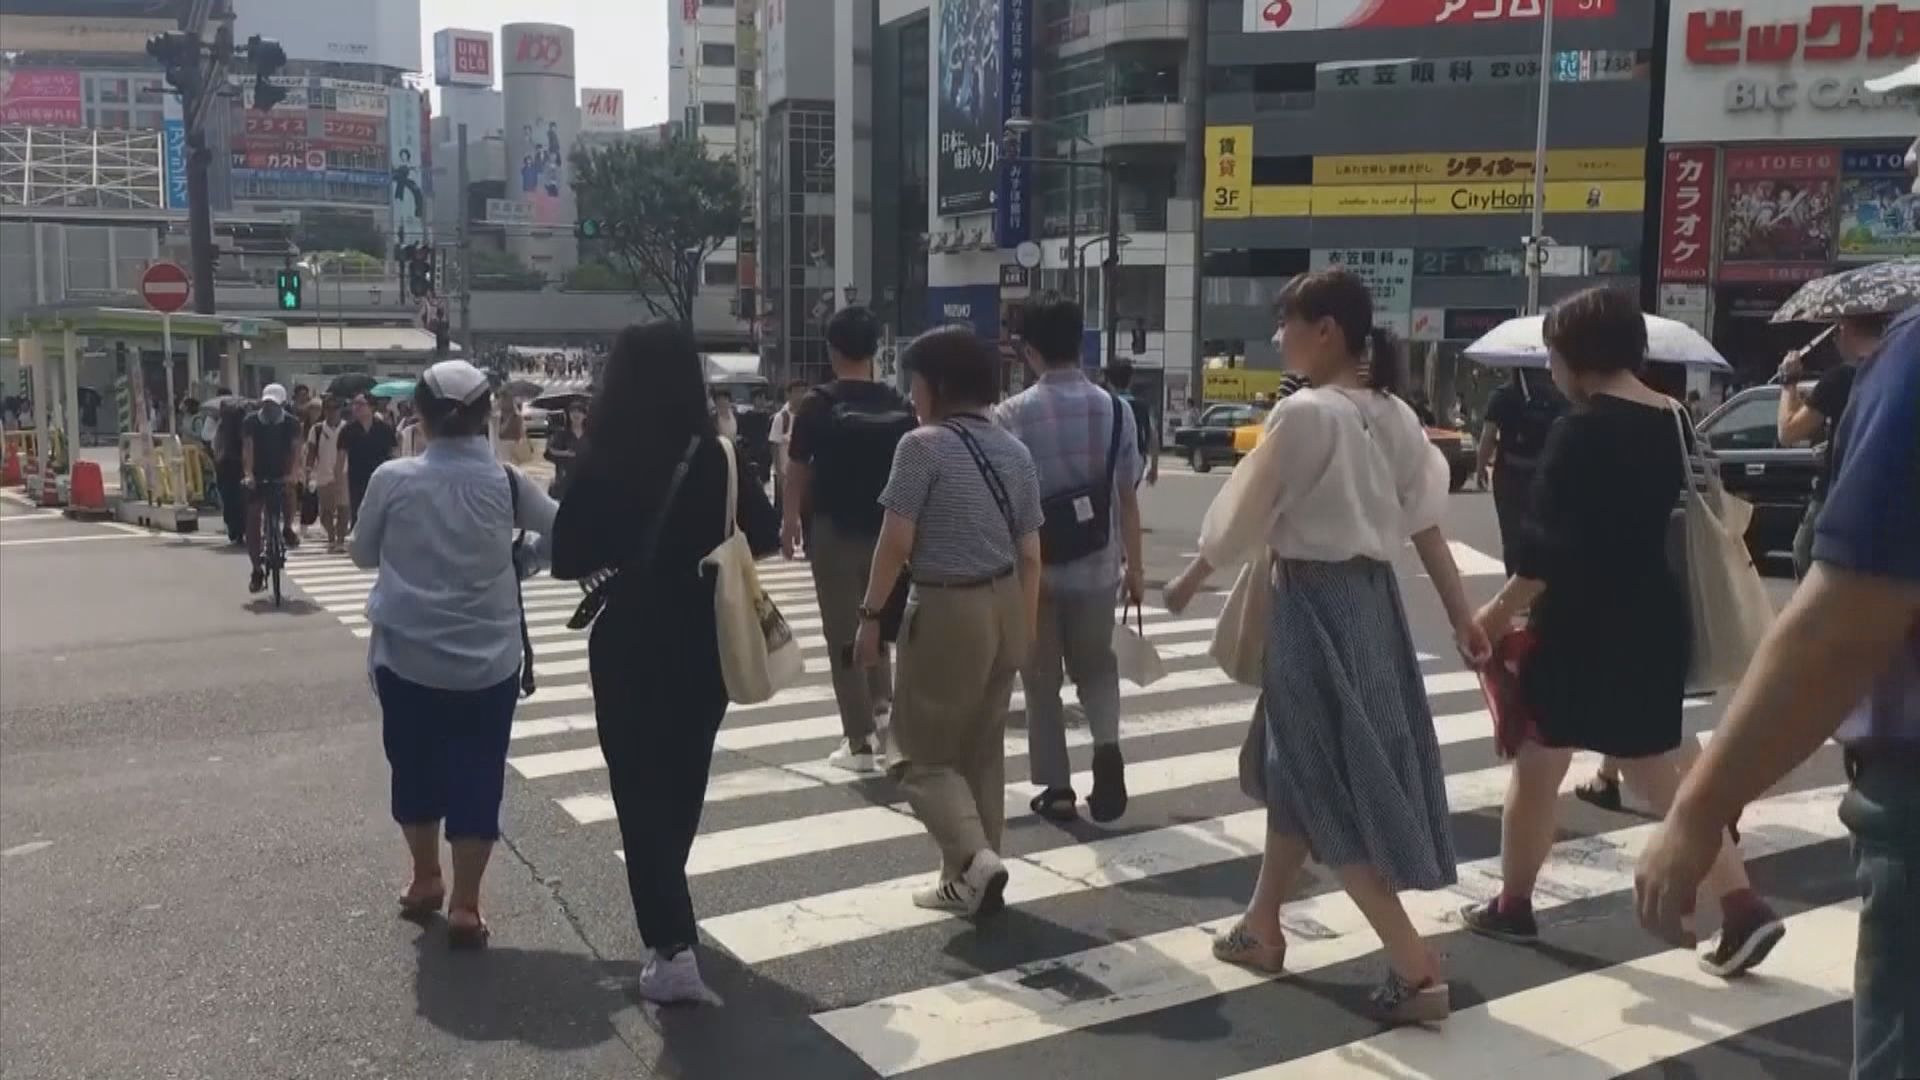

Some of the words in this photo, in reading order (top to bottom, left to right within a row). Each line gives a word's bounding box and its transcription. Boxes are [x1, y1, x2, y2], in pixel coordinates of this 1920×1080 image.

[458, 42, 485, 56] UNI
[458, 58, 487, 74] QLO
[1336, 62, 1472, 86] 衣笠眼科
[1725, 78, 1797, 112] BIC
[267, 153, 304, 168] ガスト
[1218, 138, 1236, 183] 賃貸
[1214, 188, 1239, 207] 3F
[1451, 188, 1547, 210] CityHom
[1672, 160, 1703, 263] カラオケ
[1328, 250, 1393, 266] 衣笠眼科
[1423, 252, 1456, 272] 2F
